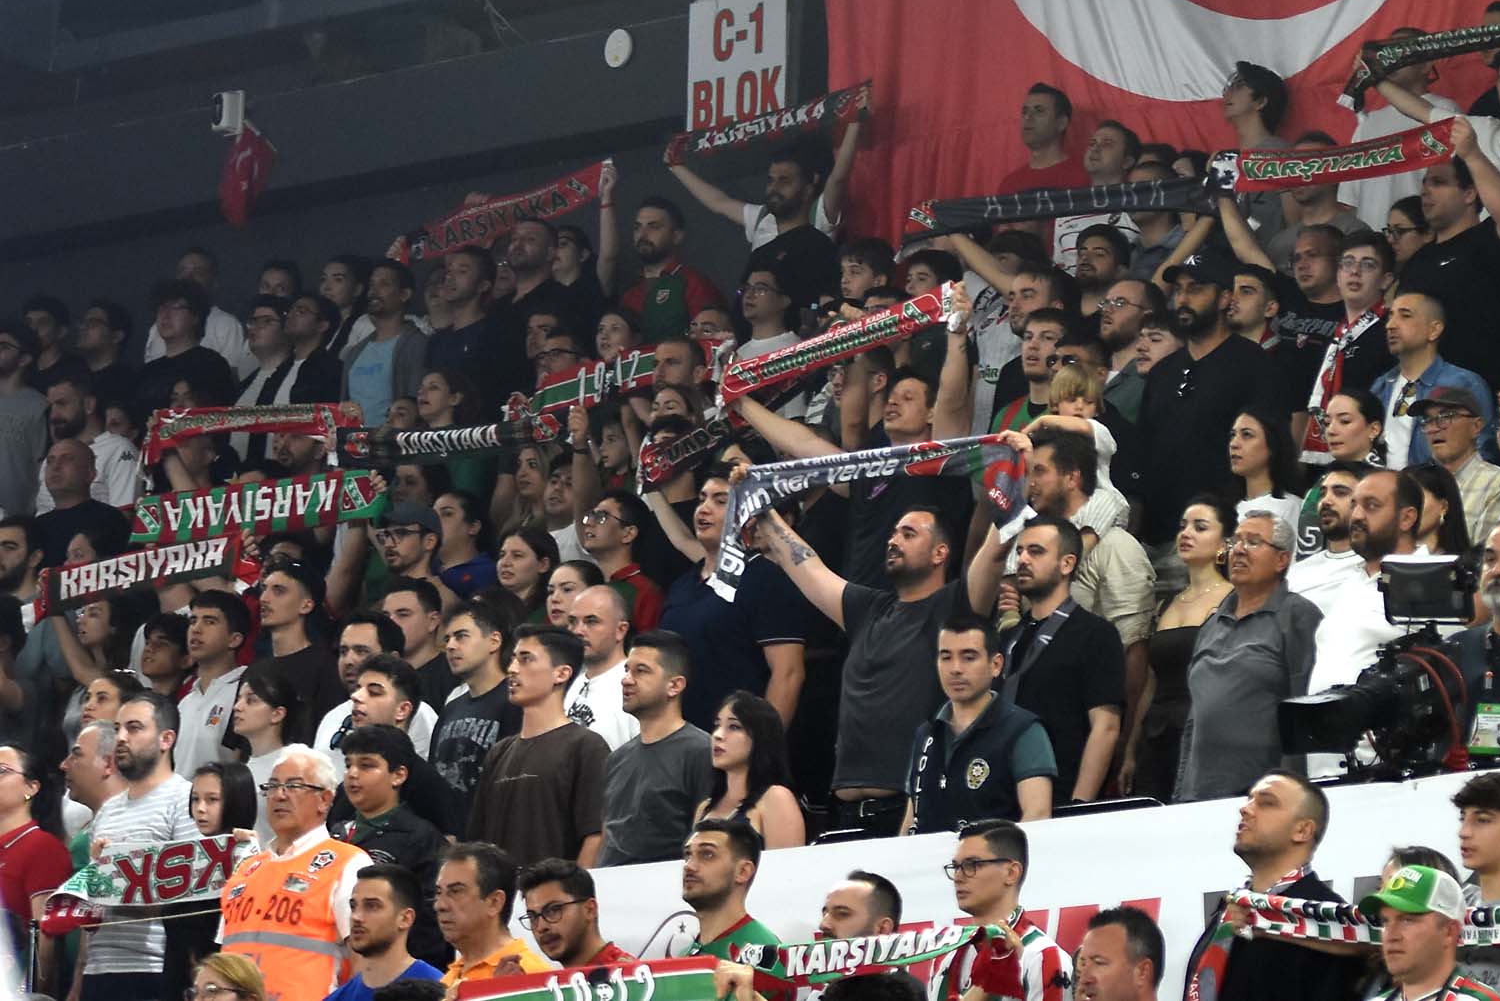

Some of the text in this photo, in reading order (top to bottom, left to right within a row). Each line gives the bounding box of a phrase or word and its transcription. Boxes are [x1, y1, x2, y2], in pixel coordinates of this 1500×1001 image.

[713, 1, 764, 62] C-1
[692, 65, 782, 132] BLOK
[1242, 144, 1405, 182] KARŞIYAKA
[396, 424, 501, 458] KARŞIYAKA
[163, 479, 338, 533] KARŞIYAKA
[774, 468, 820, 499] her
[59, 536, 228, 601] KARŞIYAKA
[112, 835, 235, 905] KSK
[262, 894, 304, 926] 206
[786, 925, 964, 978] KARŞIYAKA
